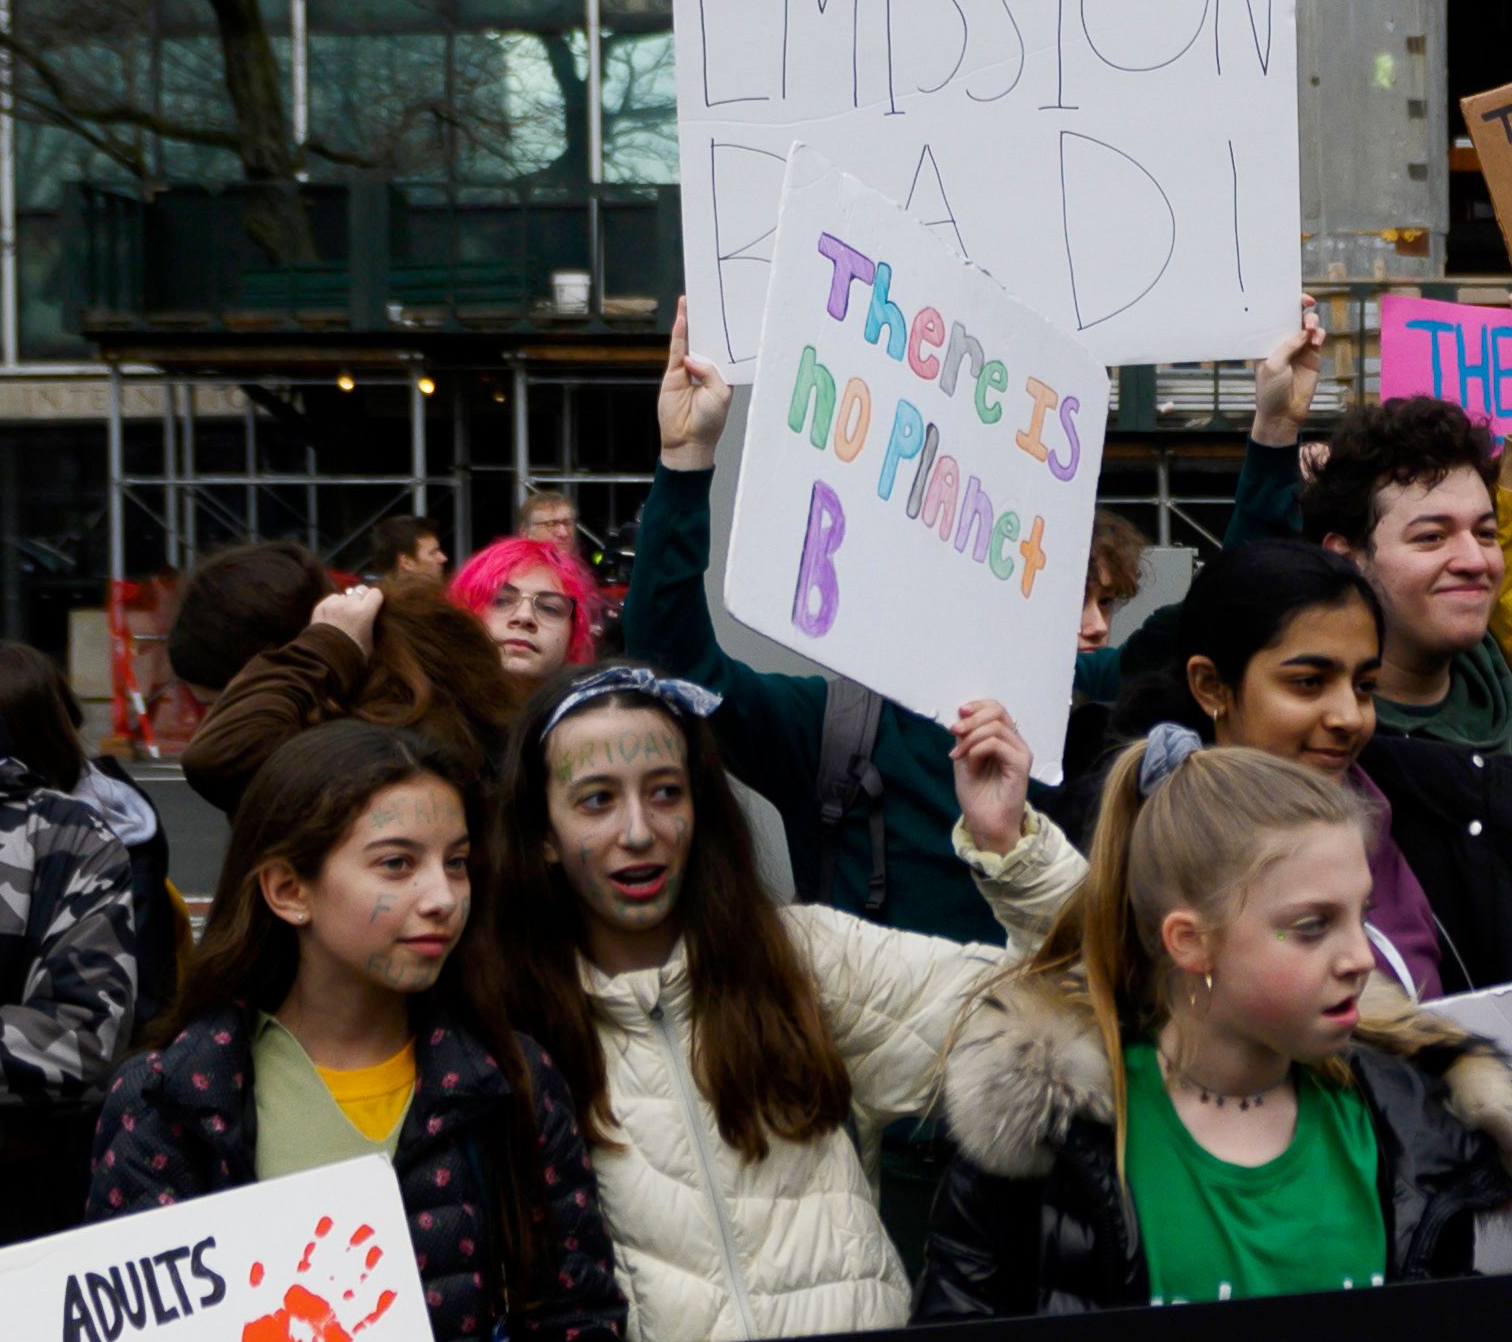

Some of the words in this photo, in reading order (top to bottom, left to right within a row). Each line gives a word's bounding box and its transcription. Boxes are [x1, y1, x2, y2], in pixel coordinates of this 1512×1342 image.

[818, 231, 1009, 425] There
[1015, 375, 1082, 482] IS
[792, 479, 846, 639] B
